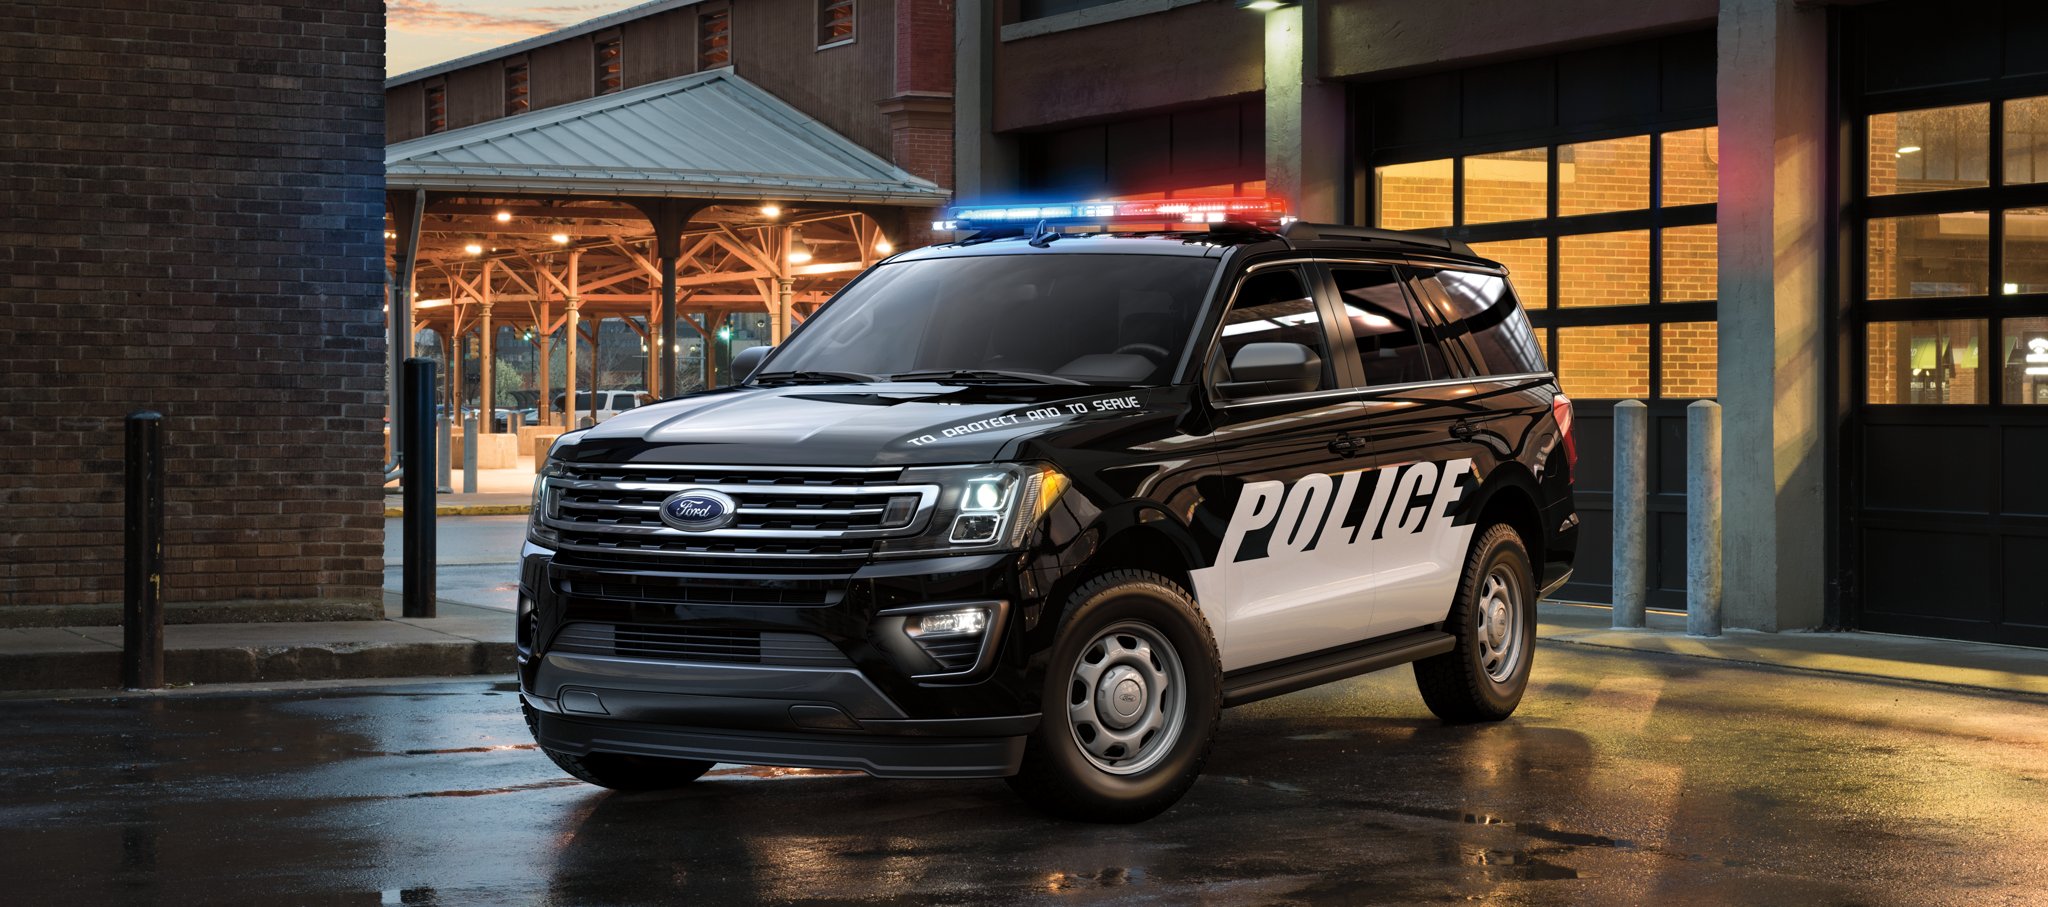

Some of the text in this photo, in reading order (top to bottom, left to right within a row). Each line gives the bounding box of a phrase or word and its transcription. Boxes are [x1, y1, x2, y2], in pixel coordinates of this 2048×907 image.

[907, 396, 1141, 446] TO PROTECT AND TO SERVE
[675, 499, 712, 518] Ford
[1213, 458, 1476, 564] POLICE
